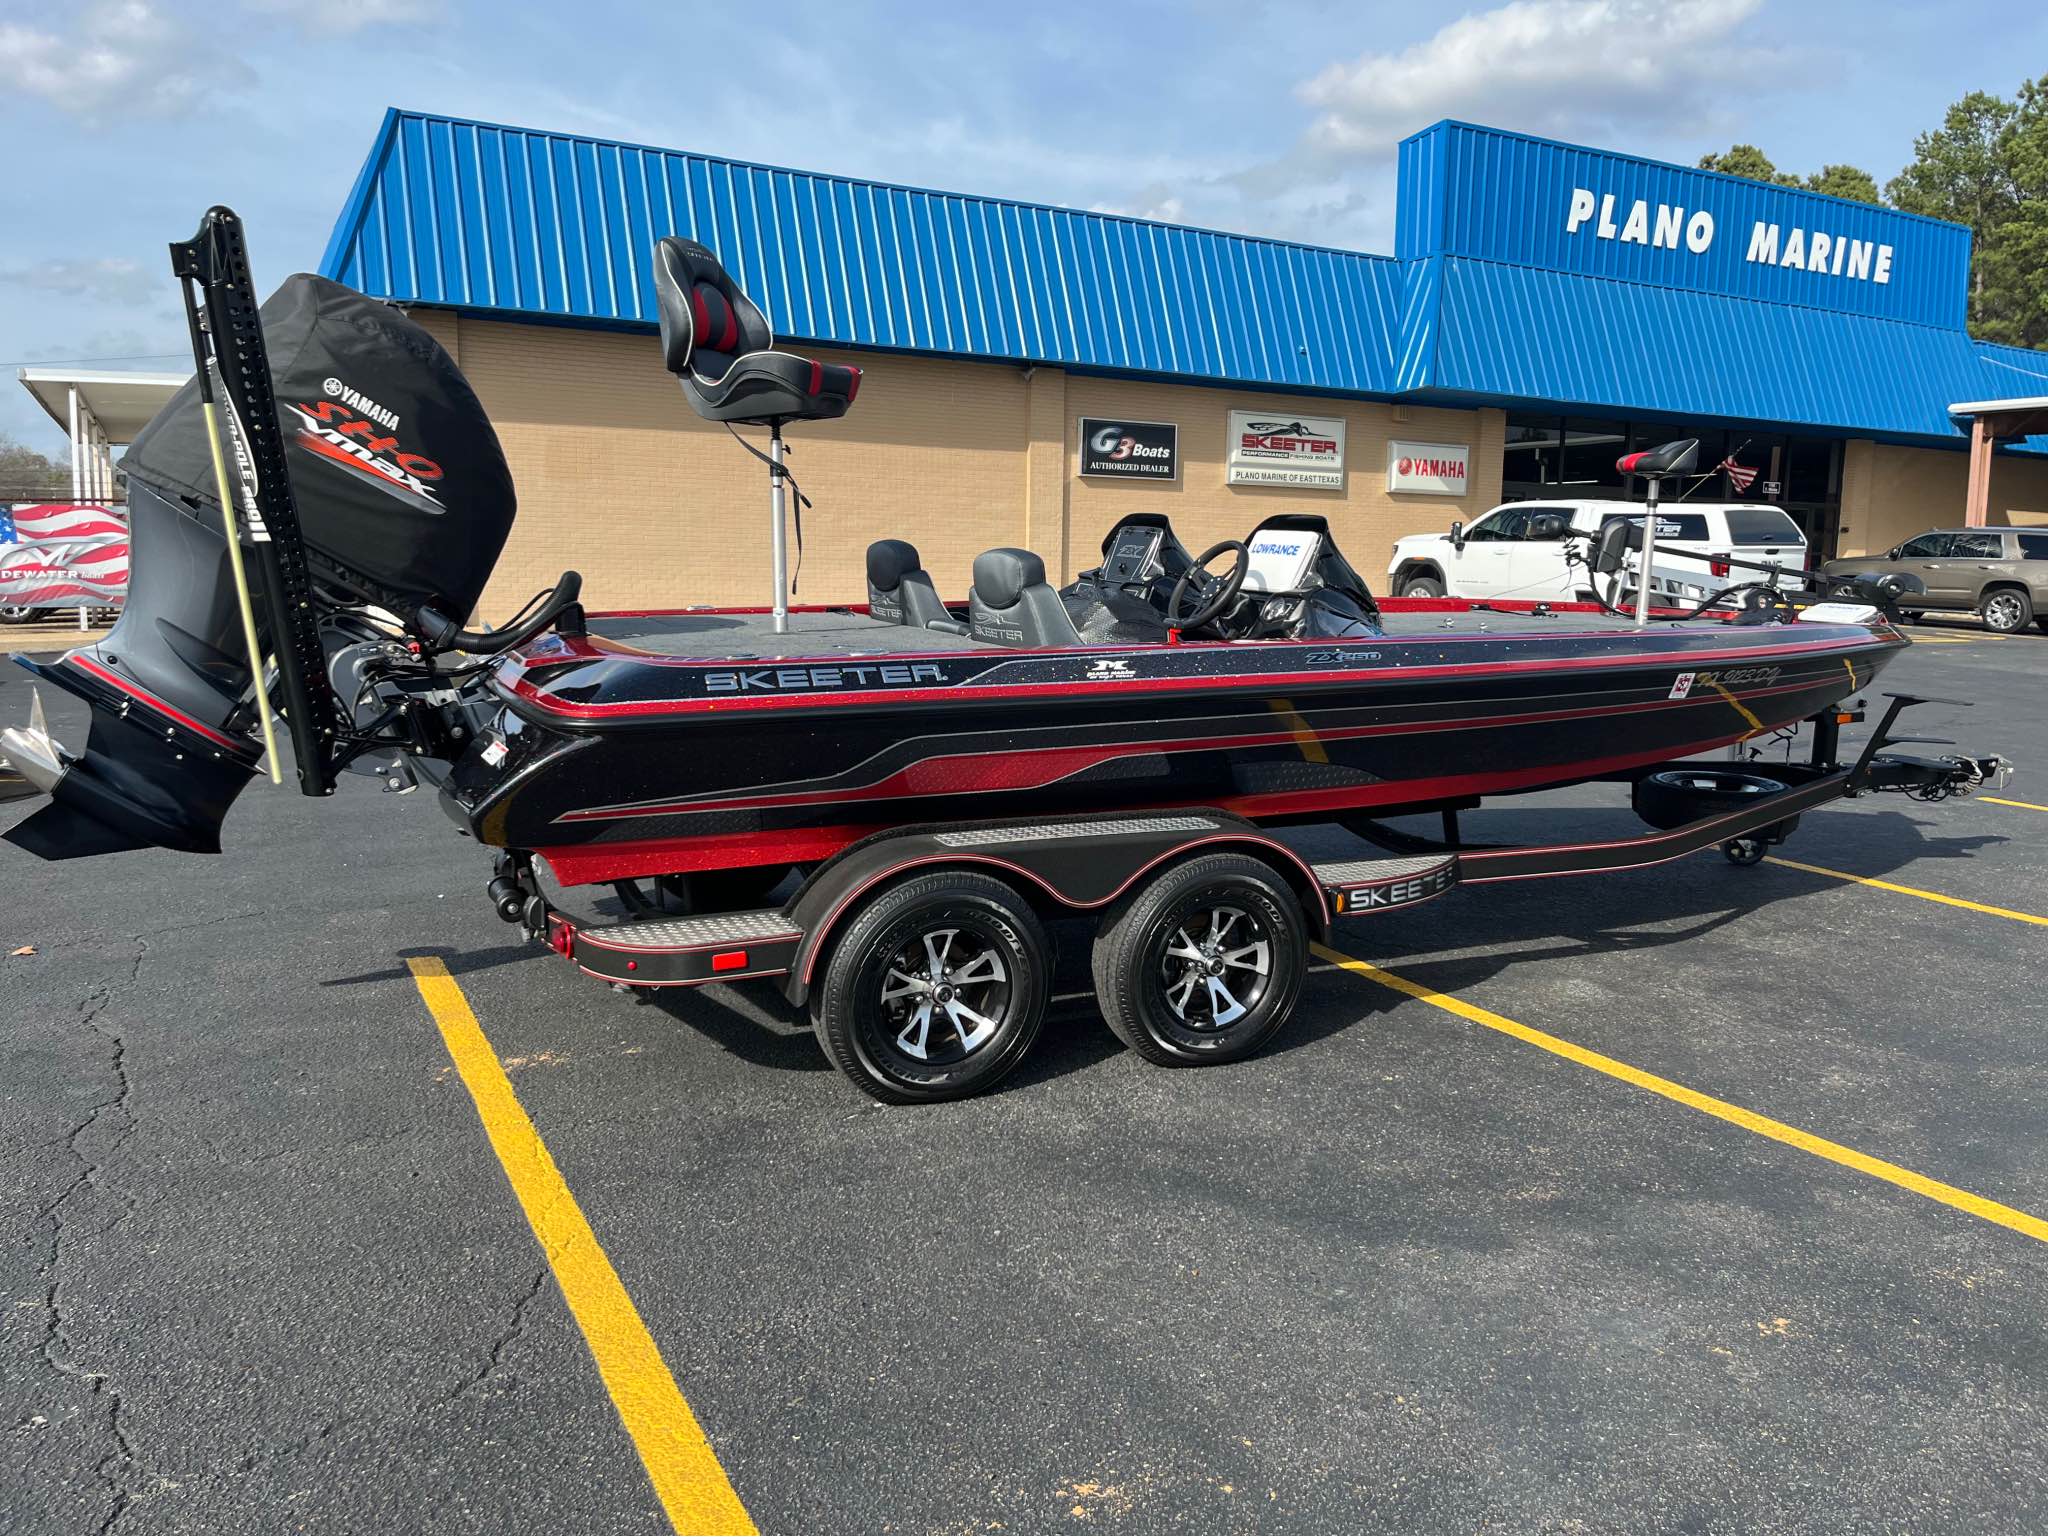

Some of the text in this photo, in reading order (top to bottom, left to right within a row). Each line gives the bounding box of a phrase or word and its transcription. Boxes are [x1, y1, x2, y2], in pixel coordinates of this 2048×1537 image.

[1566, 188, 1894, 284] PLANO MARINE
[341, 385, 400, 431] YAMAHA
[298, 401, 445, 480] SHO
[1091, 425, 1171, 460] G3 Boats
[1241, 433, 1337, 454] SKEETER
[1242, 450, 1289, 458] PERFORMANCE
[1090, 461, 1169, 473] AUTHORIZED DEALER
[1414, 458, 1465, 478] YAMAHA
[1236, 471, 1339, 484] PLANO MARINE OF EAST TEXAS
[1251, 543, 1301, 556] LOWRANCE
[975, 624, 1023, 641] SKEETER
[704, 664, 942, 691] SKEETER
